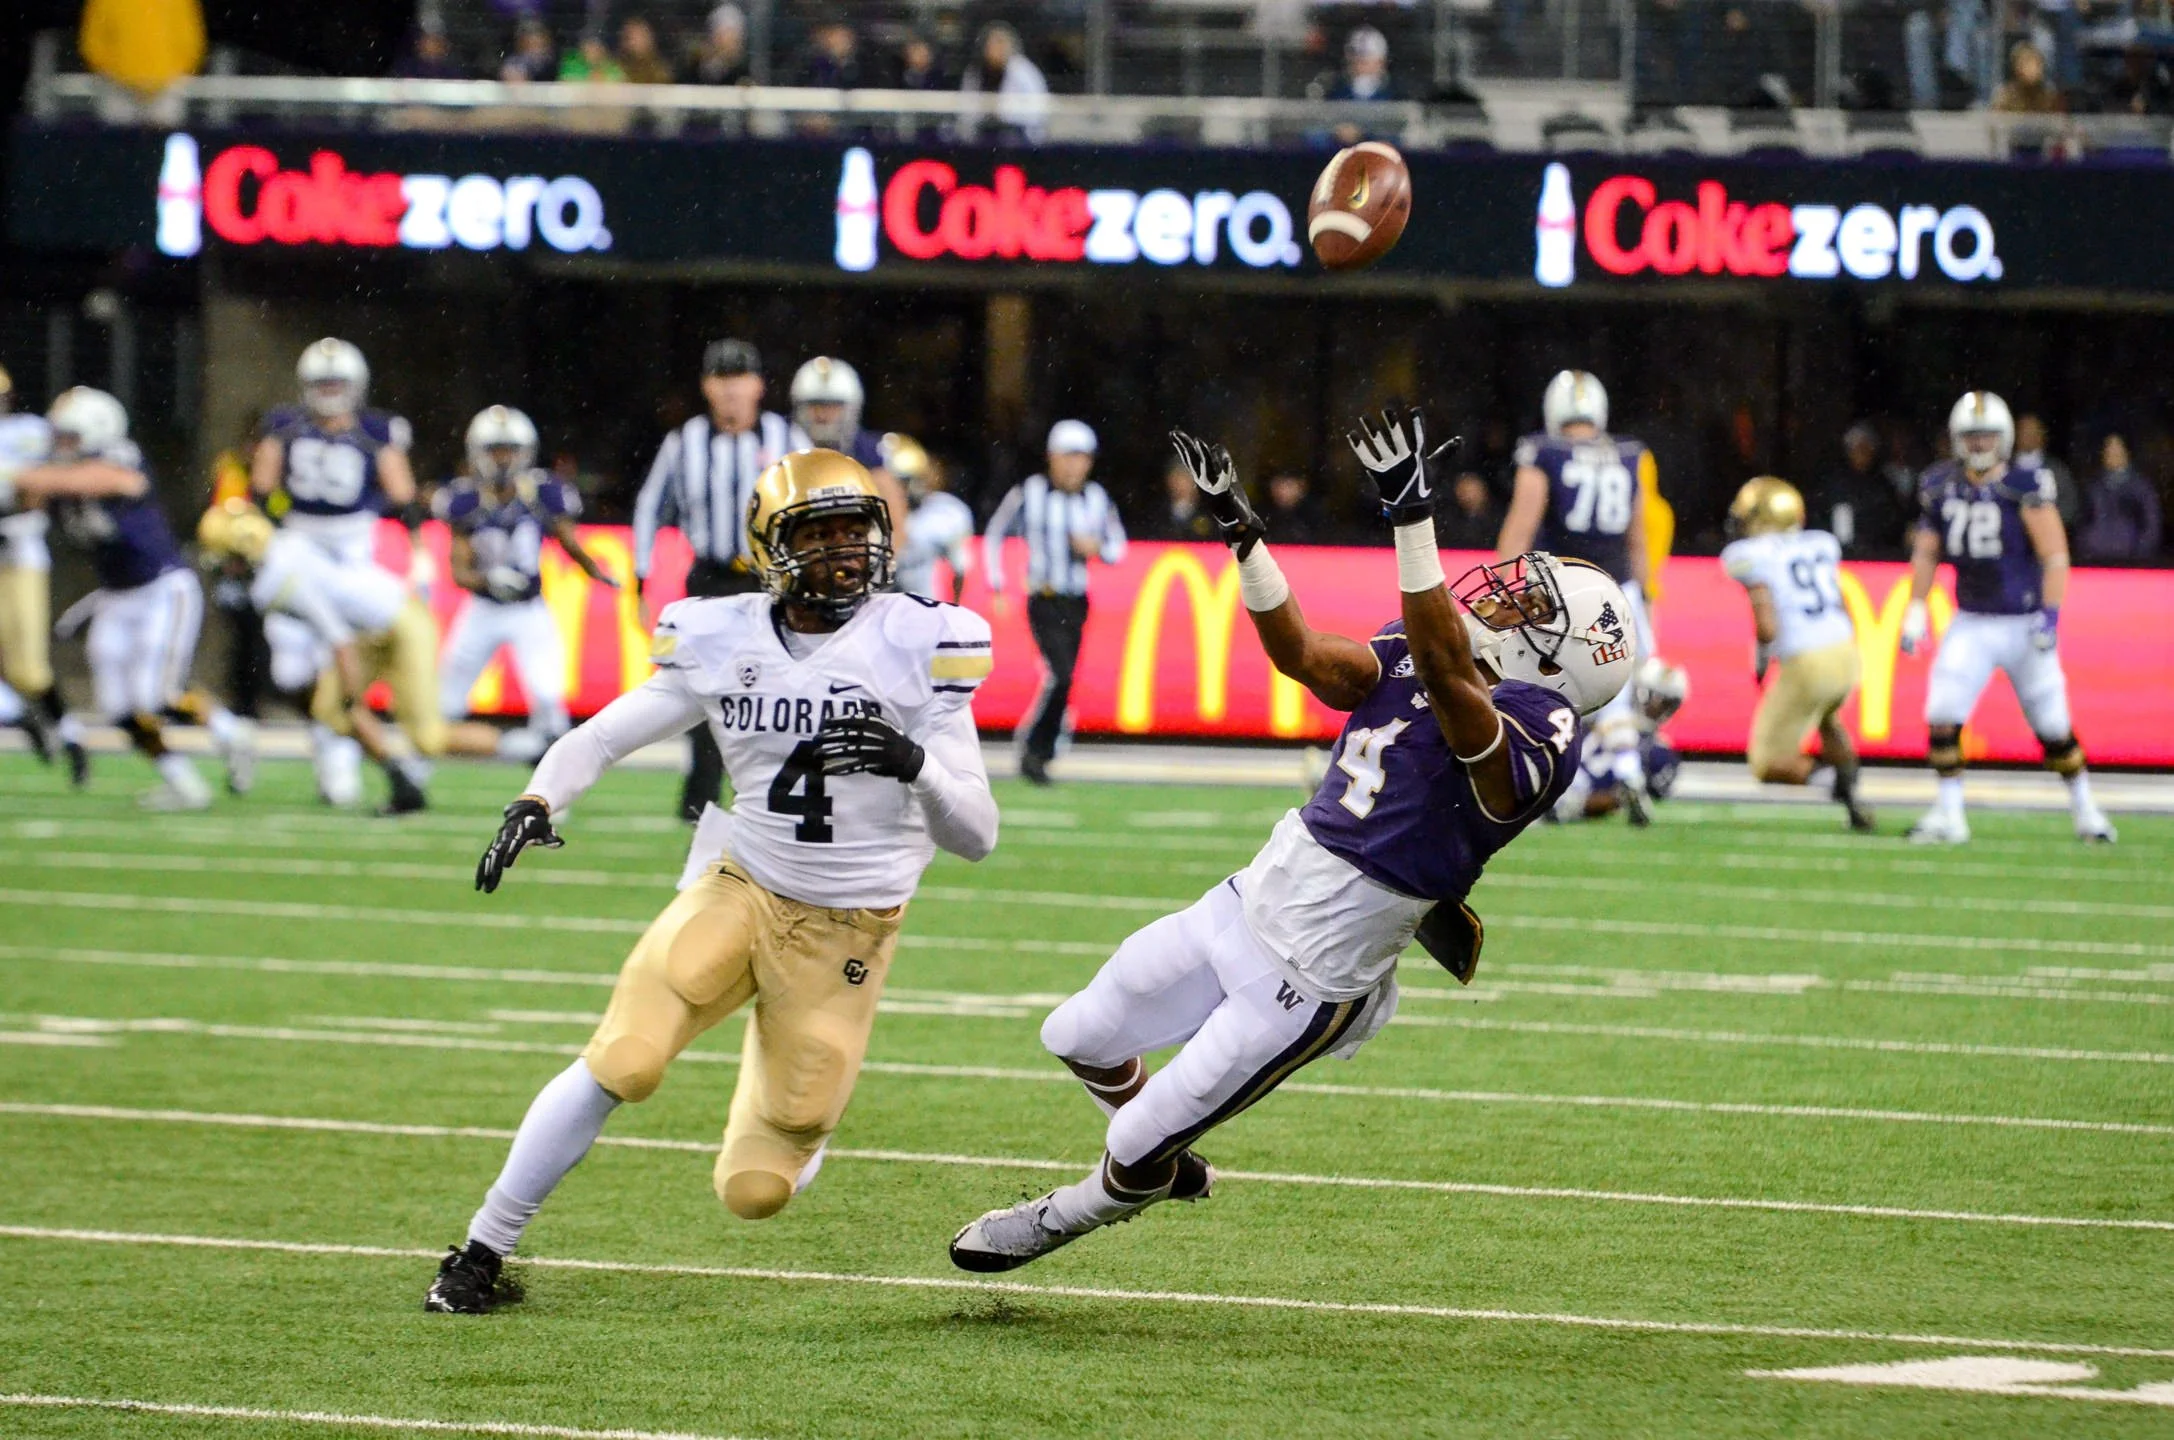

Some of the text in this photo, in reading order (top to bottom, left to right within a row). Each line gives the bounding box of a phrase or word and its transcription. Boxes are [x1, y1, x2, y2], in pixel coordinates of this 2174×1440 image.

[1561, 460, 1632, 535] 78
[1941, 499, 2003, 559] 72
[1548, 707, 1576, 754] 4
[768, 738, 833, 843] 4
[1336, 717, 1413, 820] 4
[1276, 978, 1305, 1012] W
